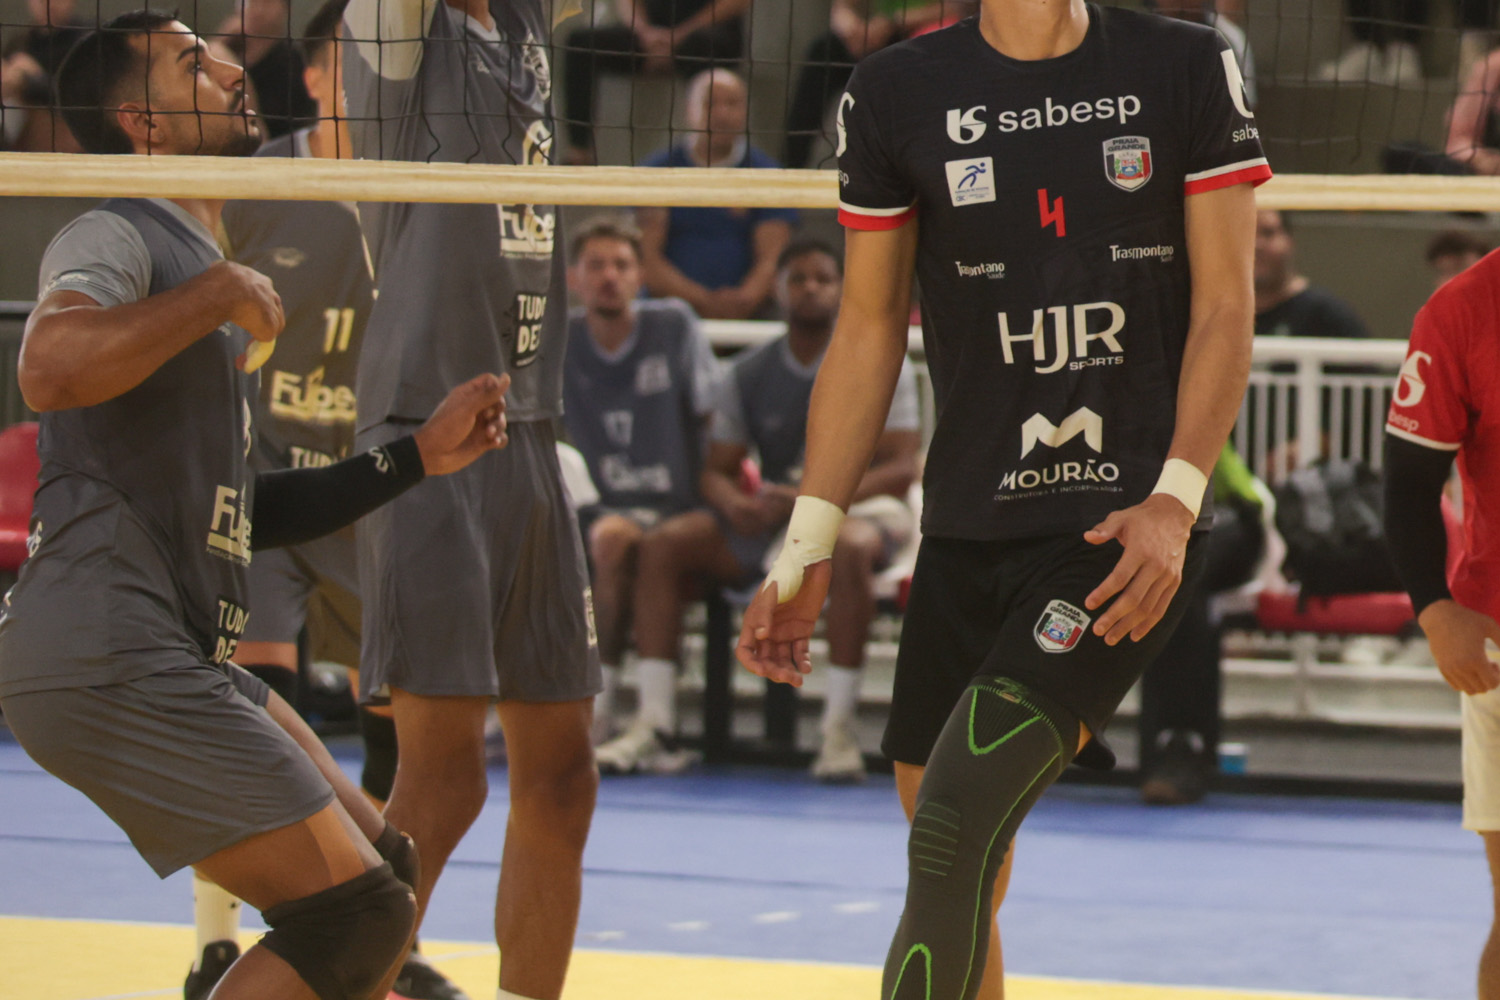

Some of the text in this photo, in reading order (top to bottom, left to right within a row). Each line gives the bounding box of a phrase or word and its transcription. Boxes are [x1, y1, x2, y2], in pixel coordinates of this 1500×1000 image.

[998, 94, 1142, 134] sabesp
[1232, 122, 1260, 143] sabe
[1037, 188, 1066, 237] 4
[323, 308, 355, 354] 11
[998, 301, 1126, 374] HJR
[1388, 408, 1420, 434] besp
[998, 458, 1120, 490] MOURÃO
